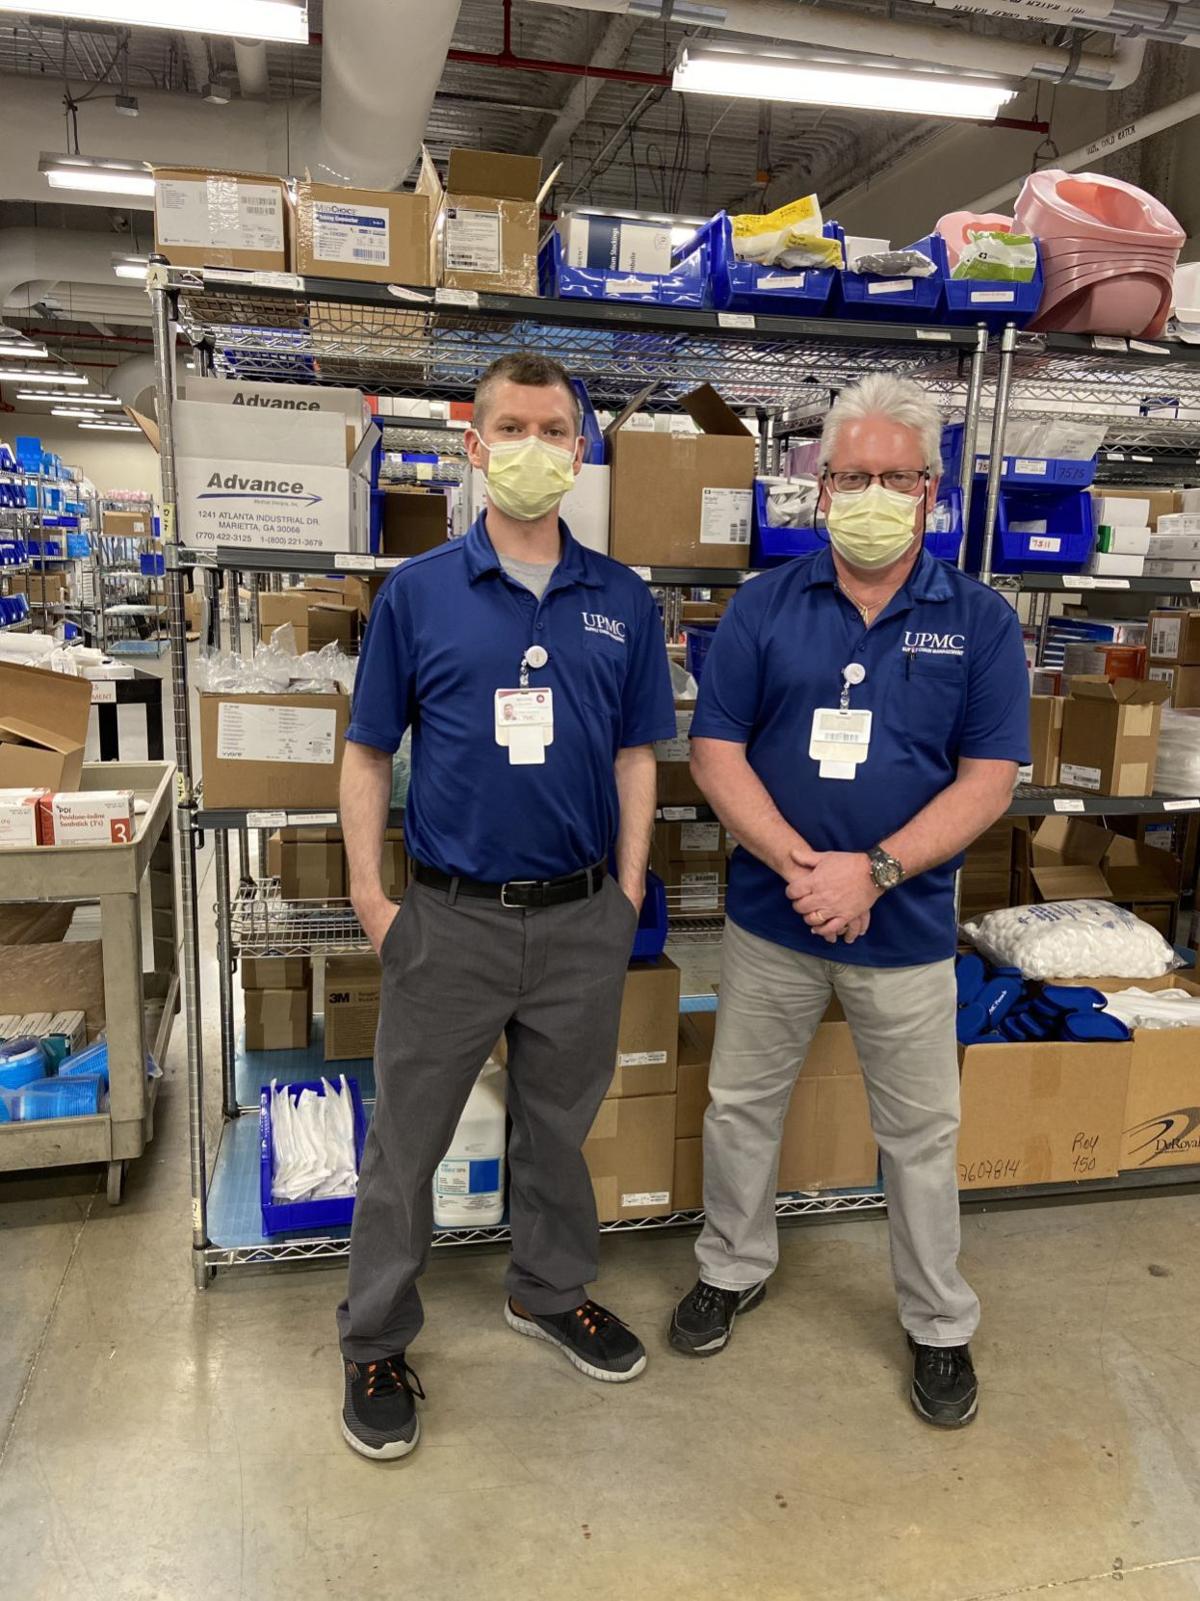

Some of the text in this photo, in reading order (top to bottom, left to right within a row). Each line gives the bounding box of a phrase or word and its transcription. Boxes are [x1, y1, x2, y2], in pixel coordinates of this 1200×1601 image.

[610, 228, 620, 256] Stockings
[232, 392, 321, 412] Advance
[206, 472, 304, 495] Advance
[198, 510, 216, 519] 1241
[219, 511, 254, 521] ATLANTA
[256, 514, 305, 525] INDUSTRIAL
[219, 521, 261, 532] MARIETTA,
[263, 524, 276, 532] GA
[195, 531, 252, 543] (770) 422-3125
[581, 611, 626, 638] UPMC
[904, 630, 965, 649] UPMC
[114, 823, 128, 844] 3
[328, 992, 350, 1004] 3M
